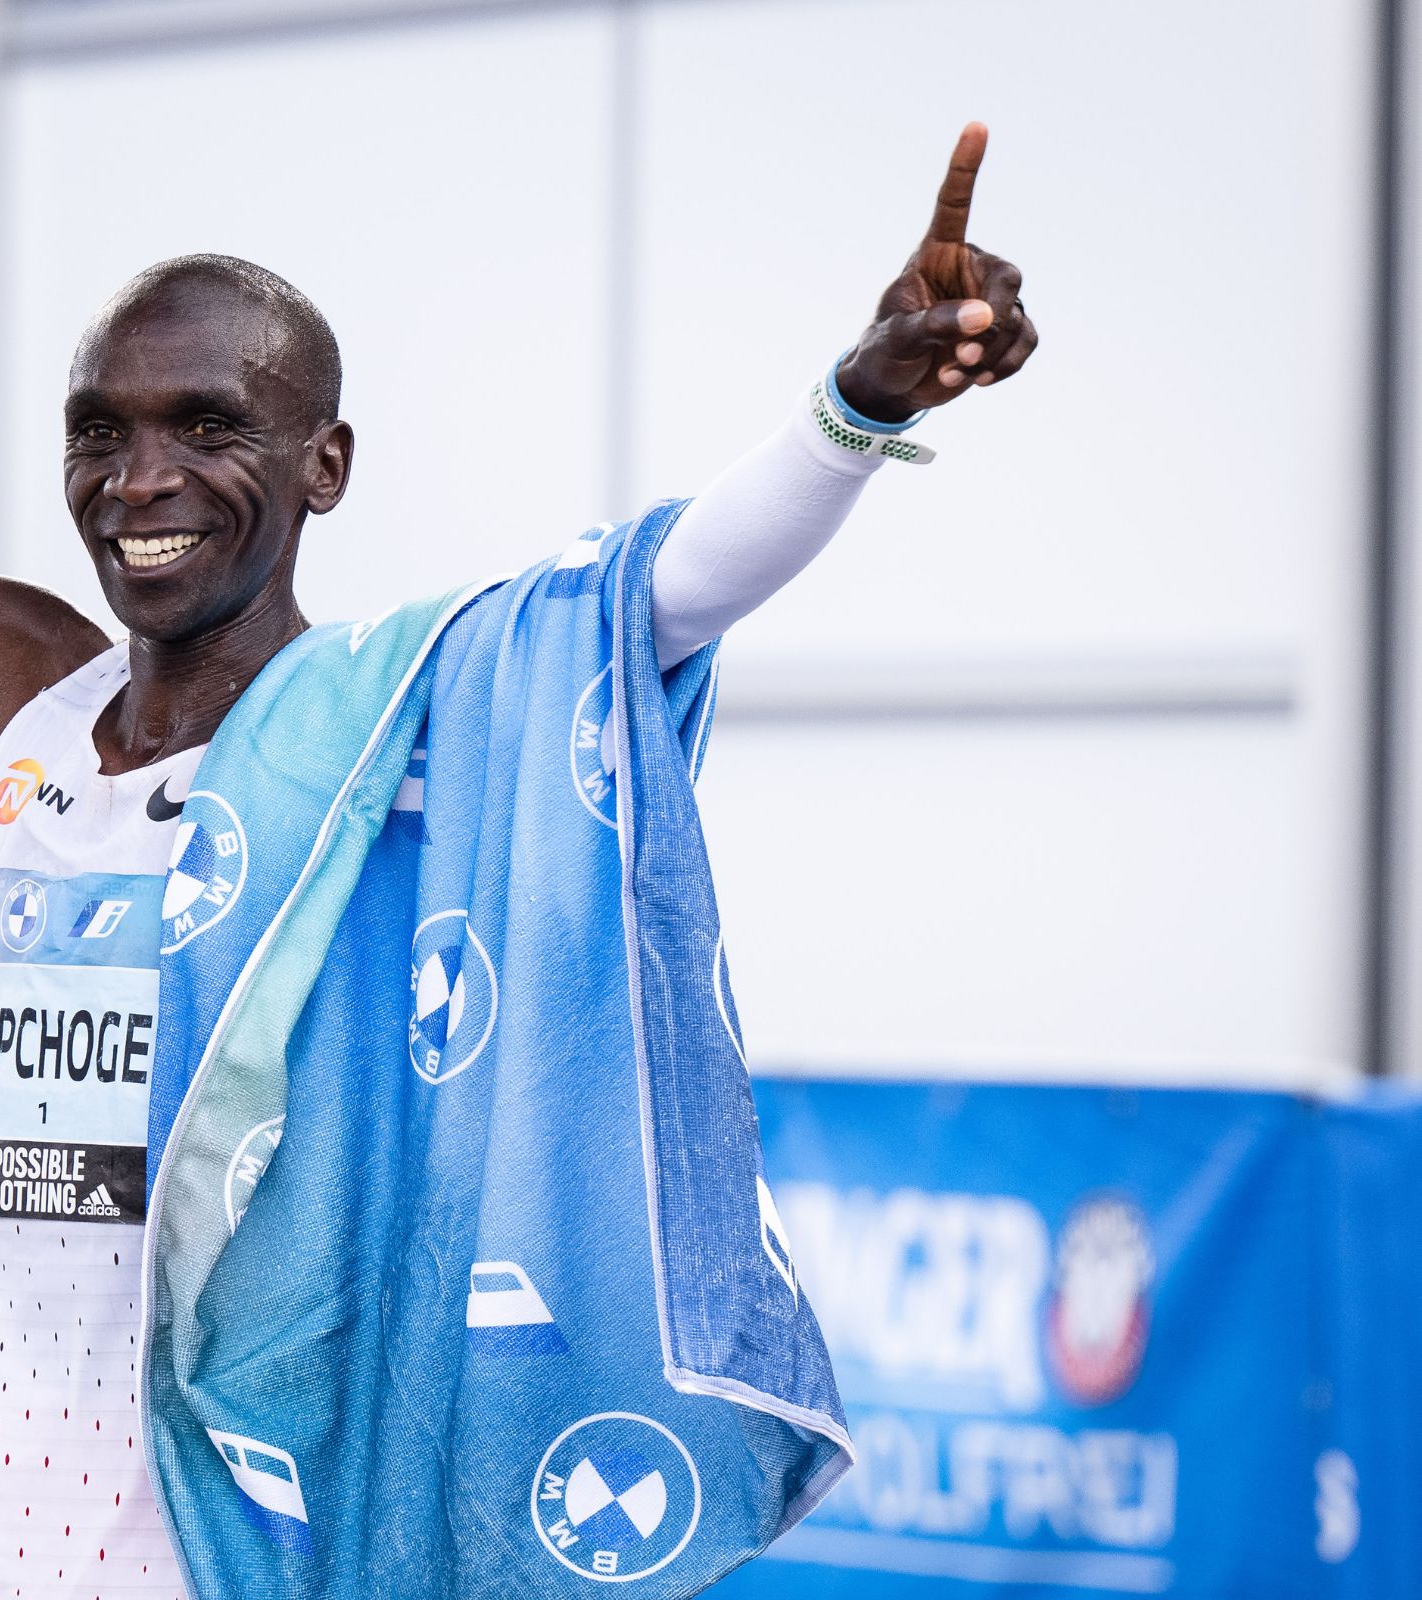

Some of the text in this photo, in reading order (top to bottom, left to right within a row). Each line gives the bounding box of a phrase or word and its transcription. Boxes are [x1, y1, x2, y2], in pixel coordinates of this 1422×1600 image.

[173, 830, 240, 940] BMW
[38, 1101, 48, 1124] 1
[78, 1203, 121, 1217] adidas
[540, 1471, 619, 1574] BMW
